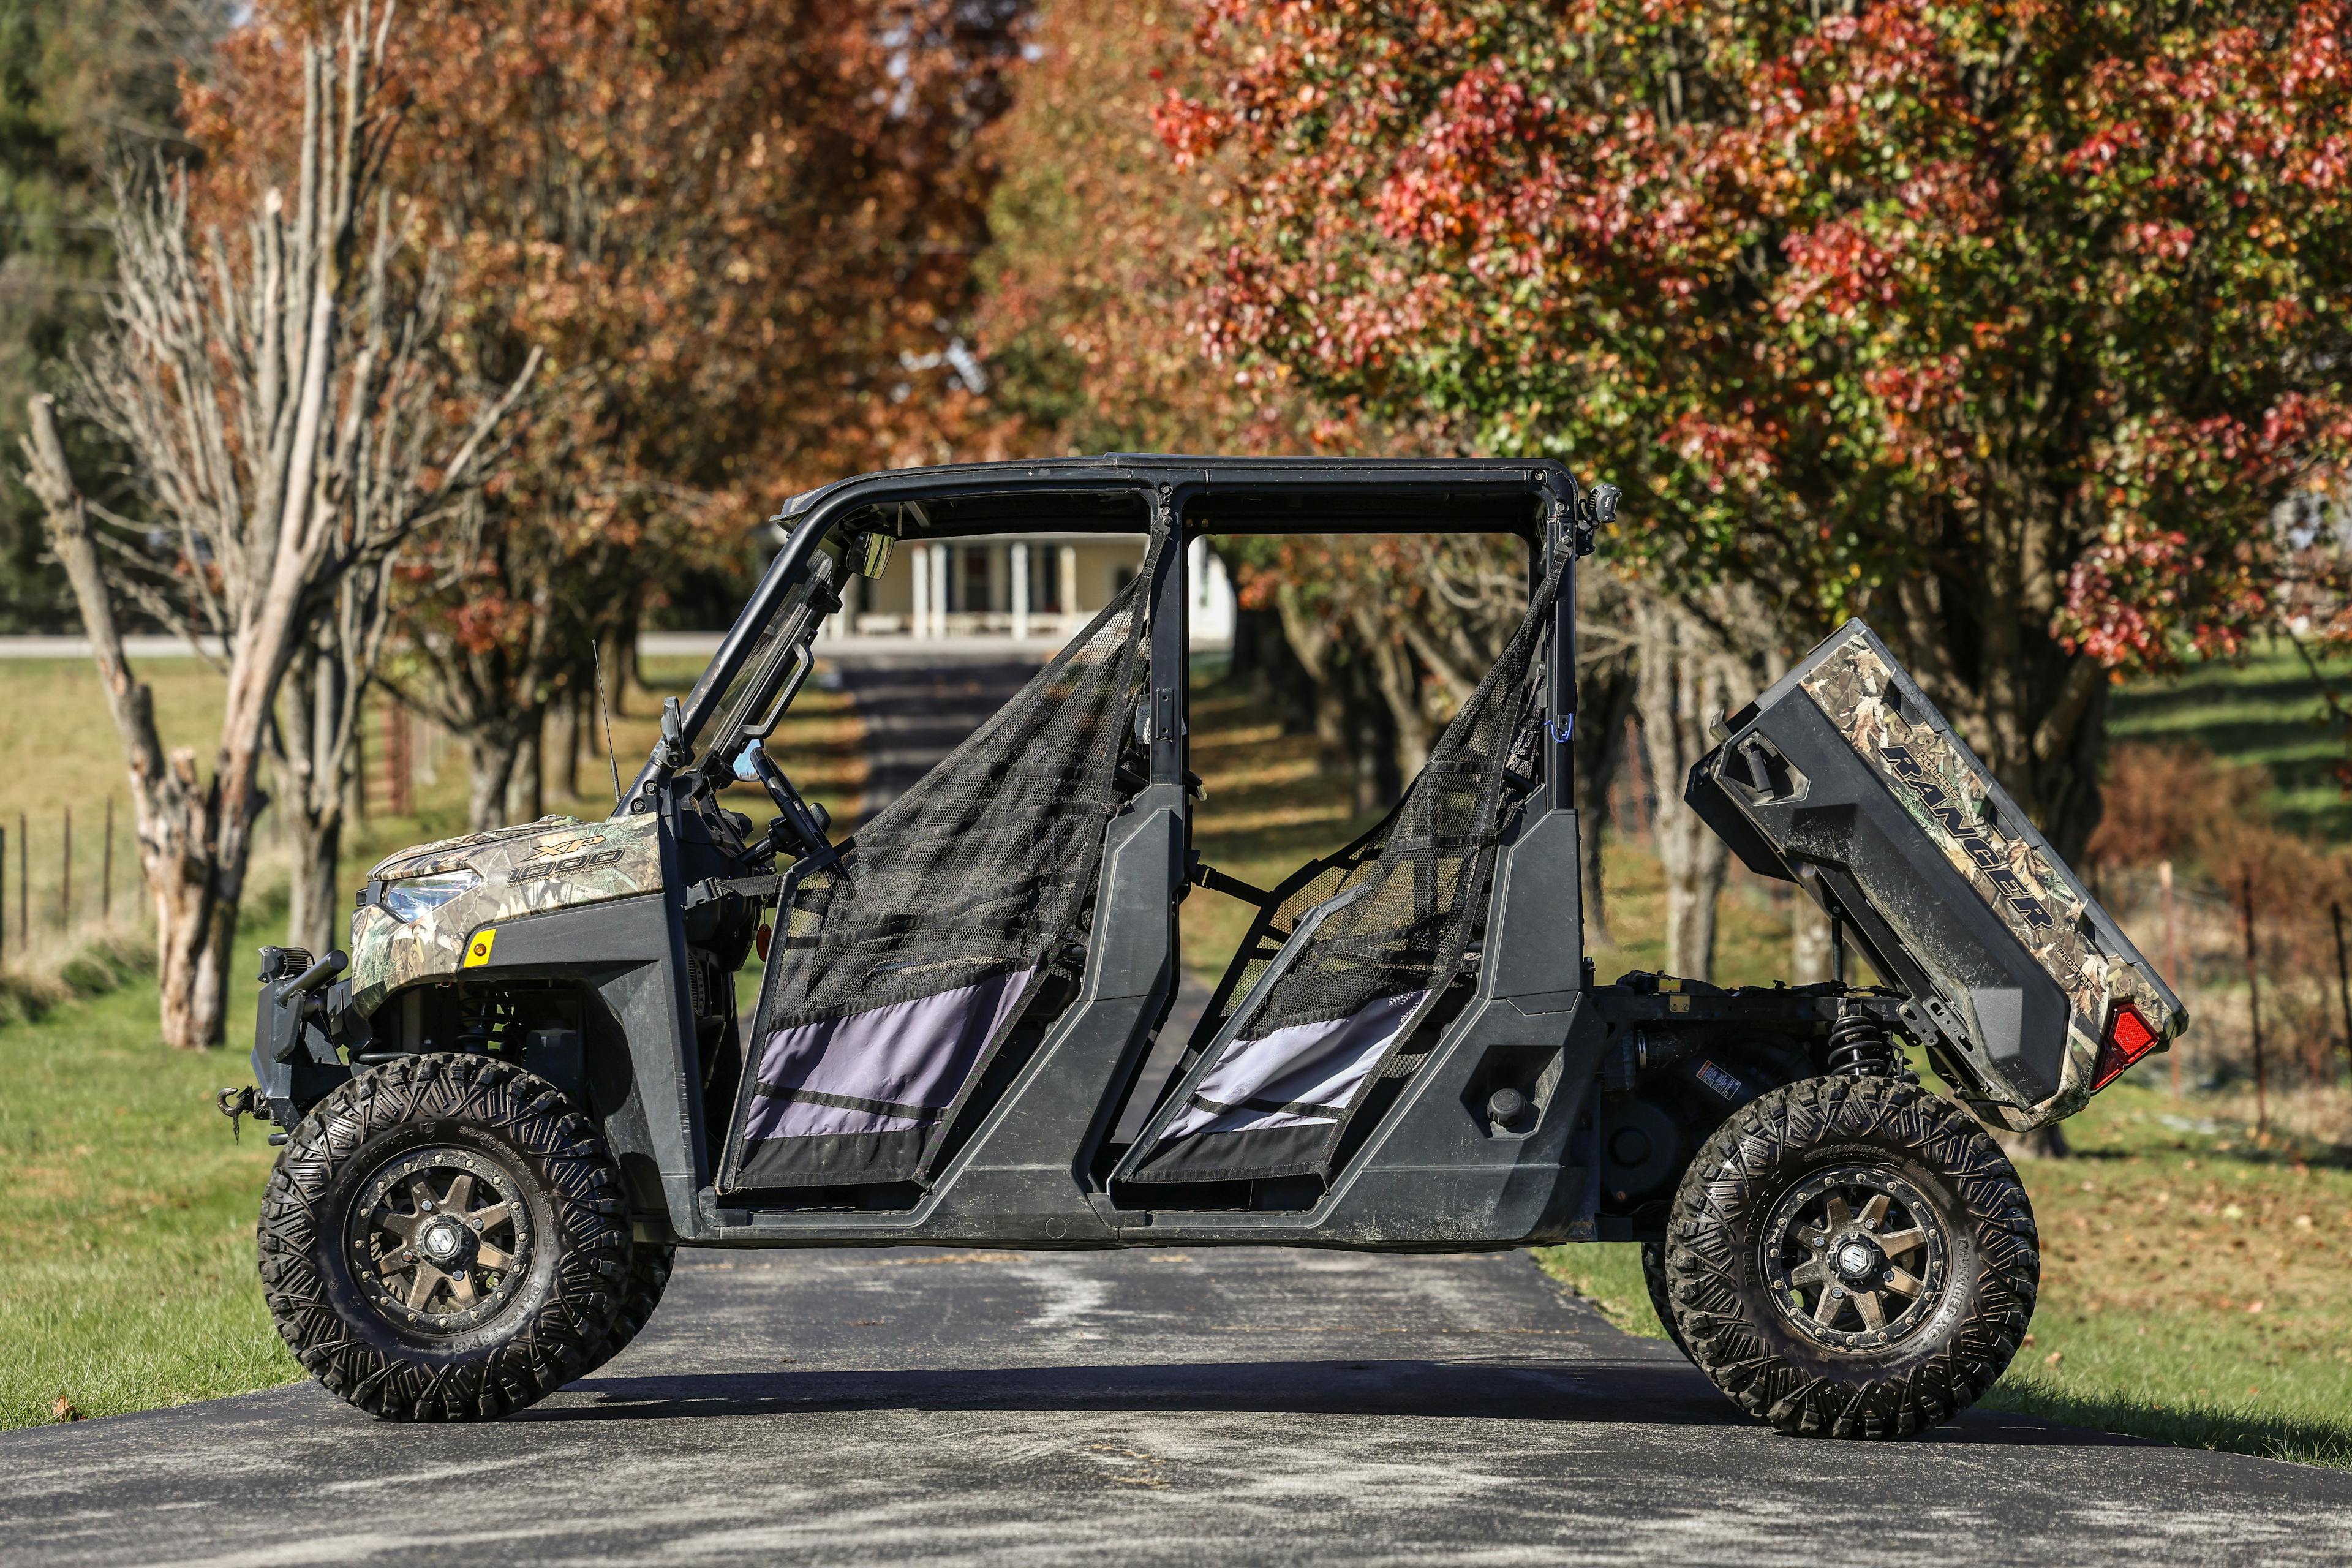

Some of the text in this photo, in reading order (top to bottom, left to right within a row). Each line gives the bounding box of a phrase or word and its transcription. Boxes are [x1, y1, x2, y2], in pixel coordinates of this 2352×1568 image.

[1916, 751, 1960, 800] POLARIS
[519, 835, 606, 862] XP
[1878, 745, 2055, 929] RANGER
[507, 848, 625, 883] 1000
[507, 862, 620, 888] DUAL OVERHEAD CAM
[2056, 946, 2094, 990] PROSTAR
[1929, 1238, 1970, 1340] CRAWLER XG
[454, 1283, 541, 1352] CRAWLER XG
